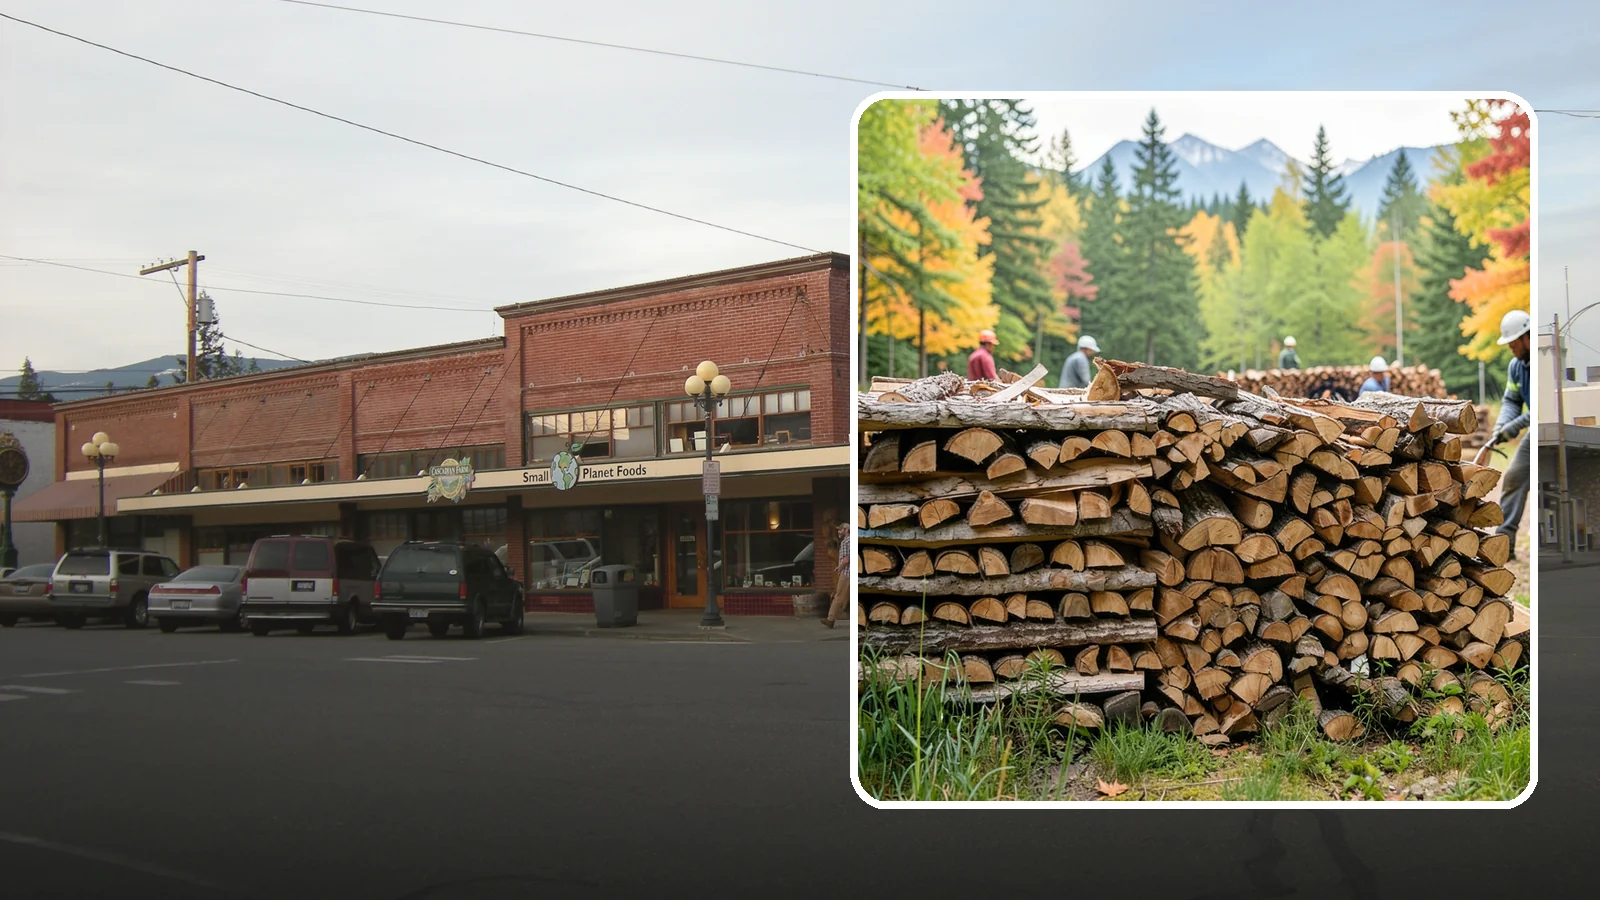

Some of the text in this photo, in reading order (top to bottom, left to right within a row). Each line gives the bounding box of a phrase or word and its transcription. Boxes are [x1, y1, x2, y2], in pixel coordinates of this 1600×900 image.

[523, 464, 647, 483] Small Planet Foods
